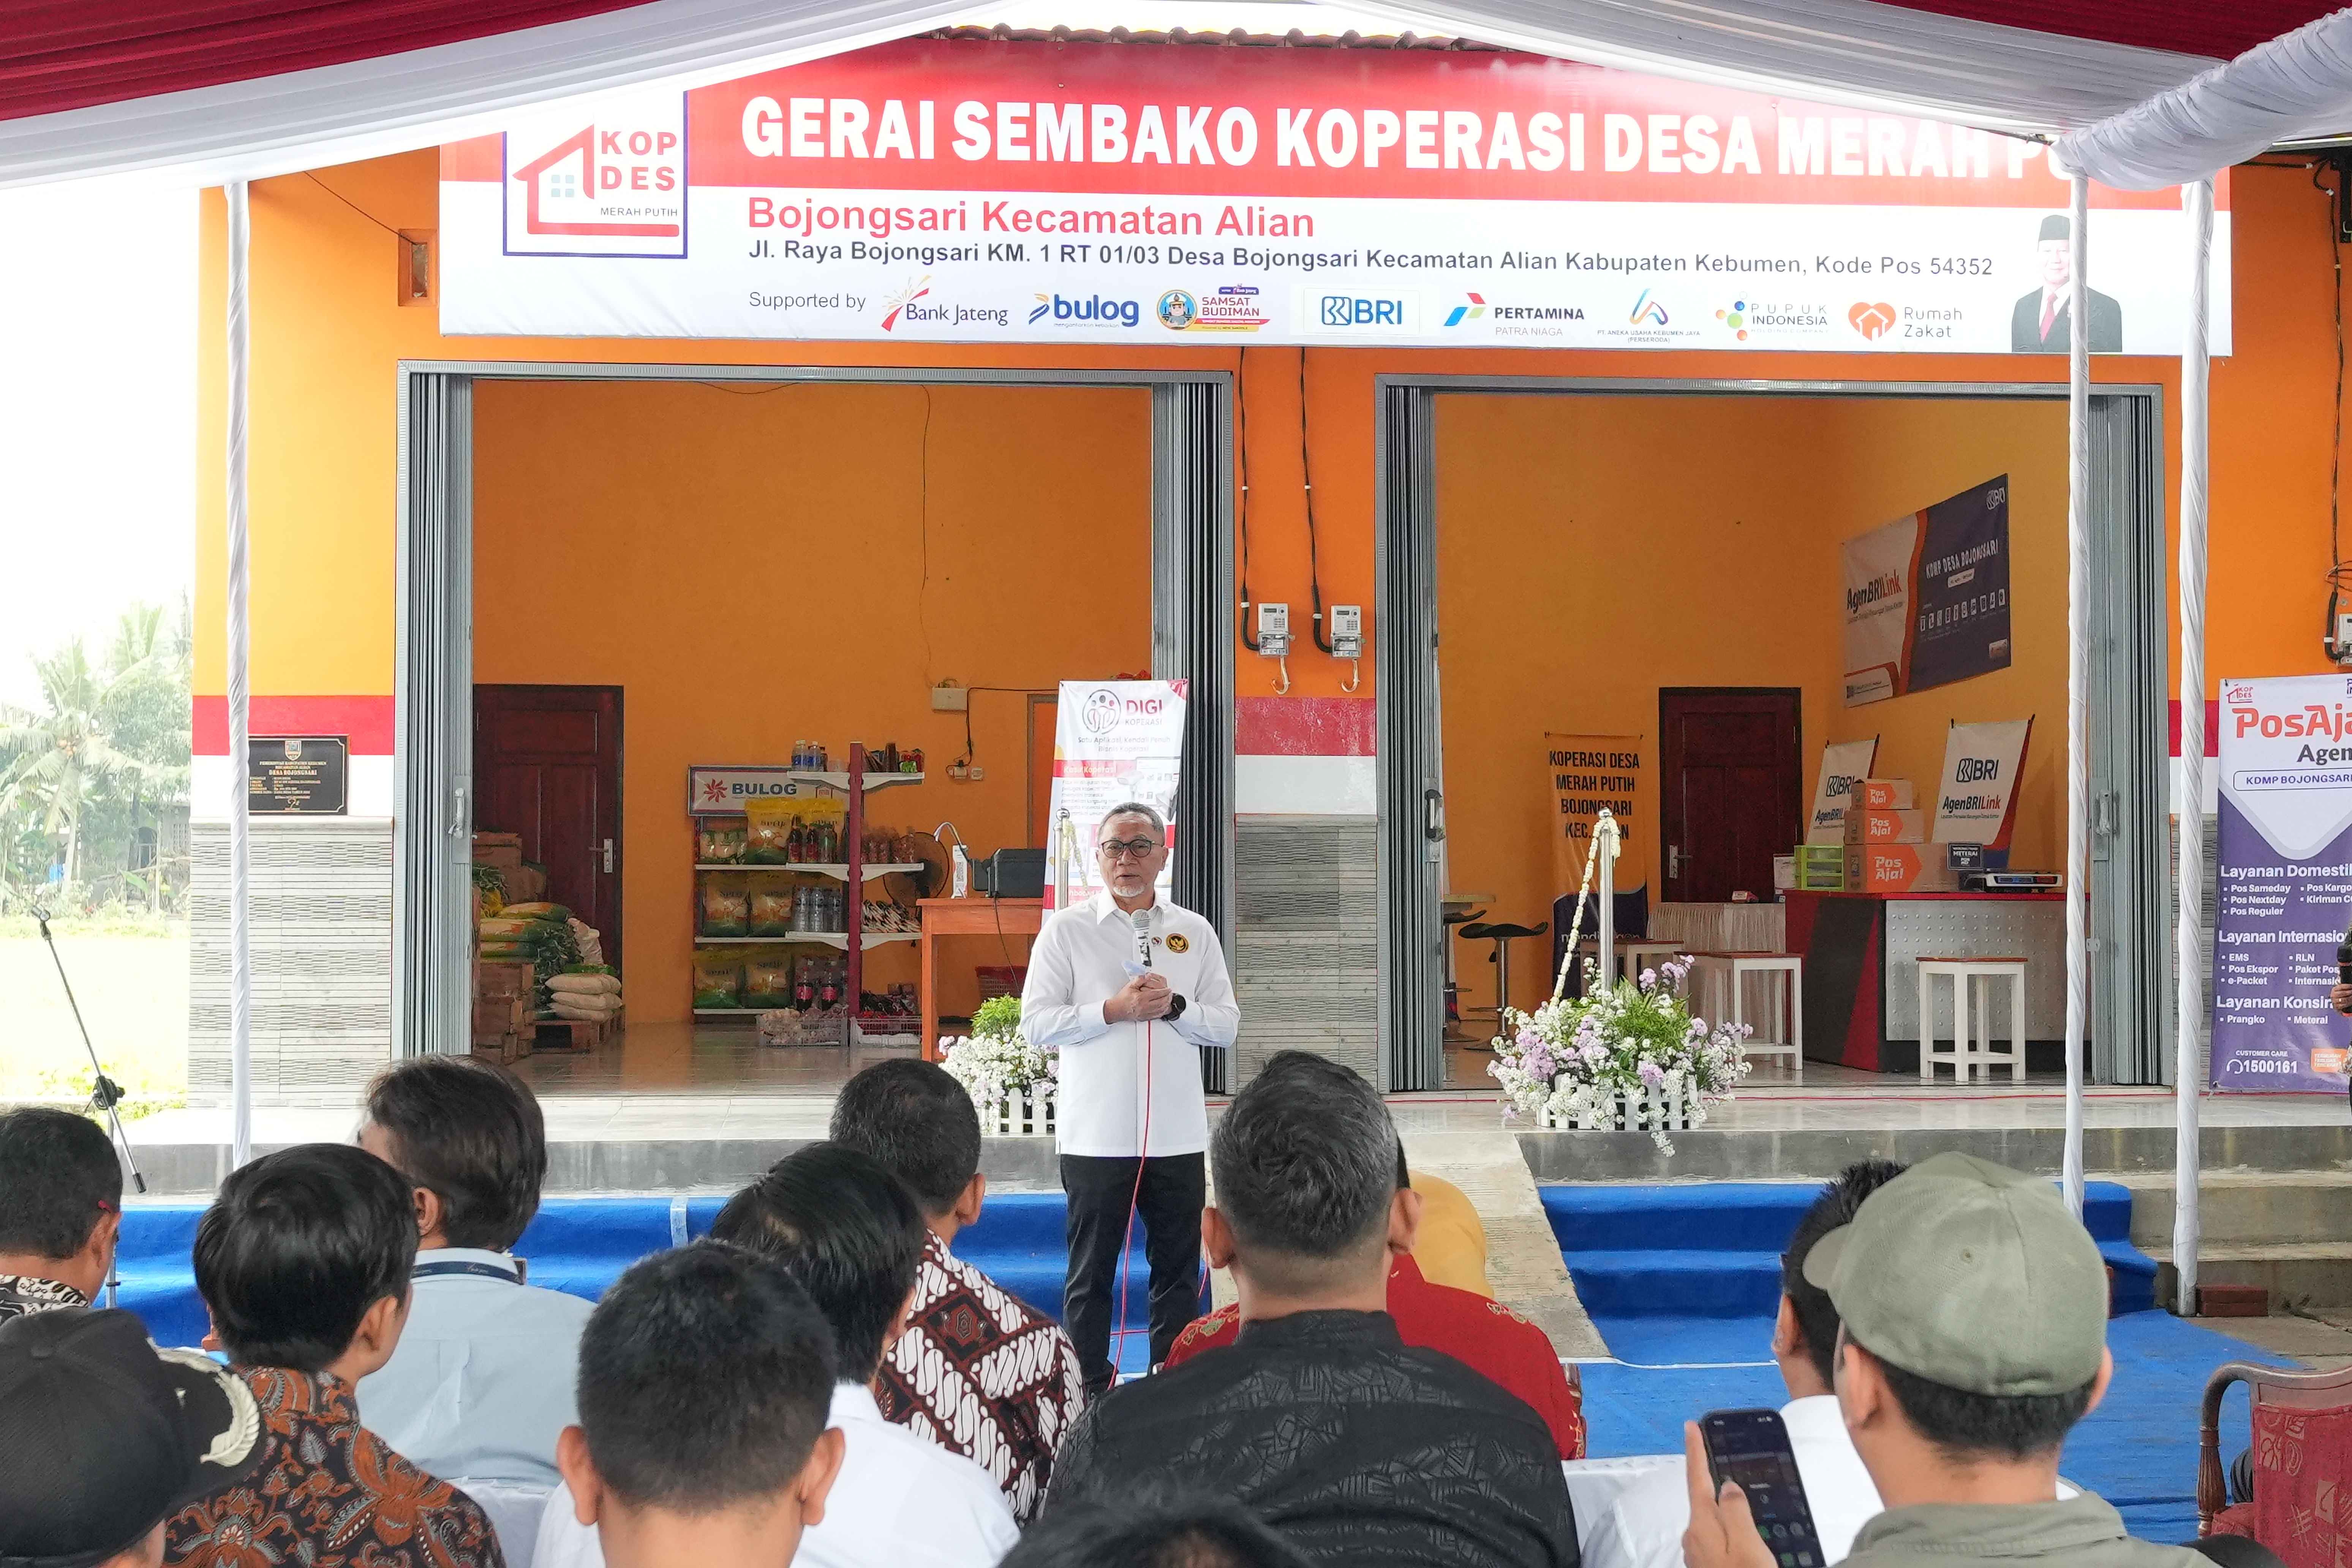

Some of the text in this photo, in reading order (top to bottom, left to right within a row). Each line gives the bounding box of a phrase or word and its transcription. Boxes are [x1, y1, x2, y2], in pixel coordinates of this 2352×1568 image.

[600, 130, 678, 157] KOP
[741, 96, 936, 161] GERAI
[952, 100, 1258, 166] SEMBAKO
[1276, 107, 1585, 171] KOPERASI
[1604, 114, 1762, 174] DESA
[1777, 117, 1989, 178] MERAH
[600, 166, 676, 191] DES
[600, 207, 678, 218] MERAH PUTIH
[748, 197, 1315, 239] Bojongsari Kecamatan Alian
[749, 240, 1993, 276] Jl. Raya Bojongsari KM. 1 RT 01/03 Desa Bojongsari Kecamatan Alian Kabupaten Kebumen, Kode Pos 54352
[749, 292, 866, 311] Supported by
[1202, 297, 1251, 306] SAMSAT
[906, 303, 1008, 326] Bank Jateng
[1054, 294, 1139, 327] bulog
[1202, 307, 1260, 316] BUDIMAN
[1355, 299, 1402, 325] BRI
[1495, 307, 1585, 320] PERTAMINA
[1751, 303, 1828, 315] PUPUK
[1903, 306, 1962, 321] Rumah
[1751, 315, 1828, 326] INDONESIA
[1495, 327, 1563, 337] PATRA NIAGA
[1904, 324, 1952, 338] Zakat
[1942, 553, 1961, 574] DESA
[1847, 569, 1902, 615] AgenBRILink
[1126, 700, 1162, 716] DIGI
[1549, 750, 1640, 769] KOPERASI DESA
[2297, 744, 2352, 765] Agen
[1973, 759, 2000, 781] BRI
[1556, 774, 1635, 792] MERAH PUTIH
[2246, 776, 2279, 785] KDMP
[732, 783, 797, 795] BULOG
[1942, 794, 2001, 814] AgenBRILink
[1815, 808, 1845, 825] AgenBRIL
[1870, 817, 1890, 827] Pos
[1565, 822, 1591, 839] KEC.
[1870, 825, 1891, 837] Aja!
[1874, 856, 1902, 868] Pos
[1875, 868, 1904, 882] Aja!
[2221, 865, 2284, 880] Layanan
[2230, 884, 2291, 894] Pos Sameday
[2325, 883, 2352, 893] Kargo
[2230, 895, 2287, 906] Pos Nextday
[2306, 895, 2352, 904] Kiriman C
[2230, 906, 2284, 917] Pos Reguler
[2218, 929, 2347, 946] Layanan Internasio
[2229, 953, 2249, 962] EMS
[2295, 953, 2315, 962] RLN
[2229, 964, 2279, 975] Pos Ekspor
[2295, 965, 2340, 974] Paket Pos
[2227, 976, 2268, 985] e-Packet
[2216, 995, 2334, 1011] Layanan Konsin
[2227, 1015, 2265, 1025] Prangko
[2243, 1059, 2298, 1073] 1500161
